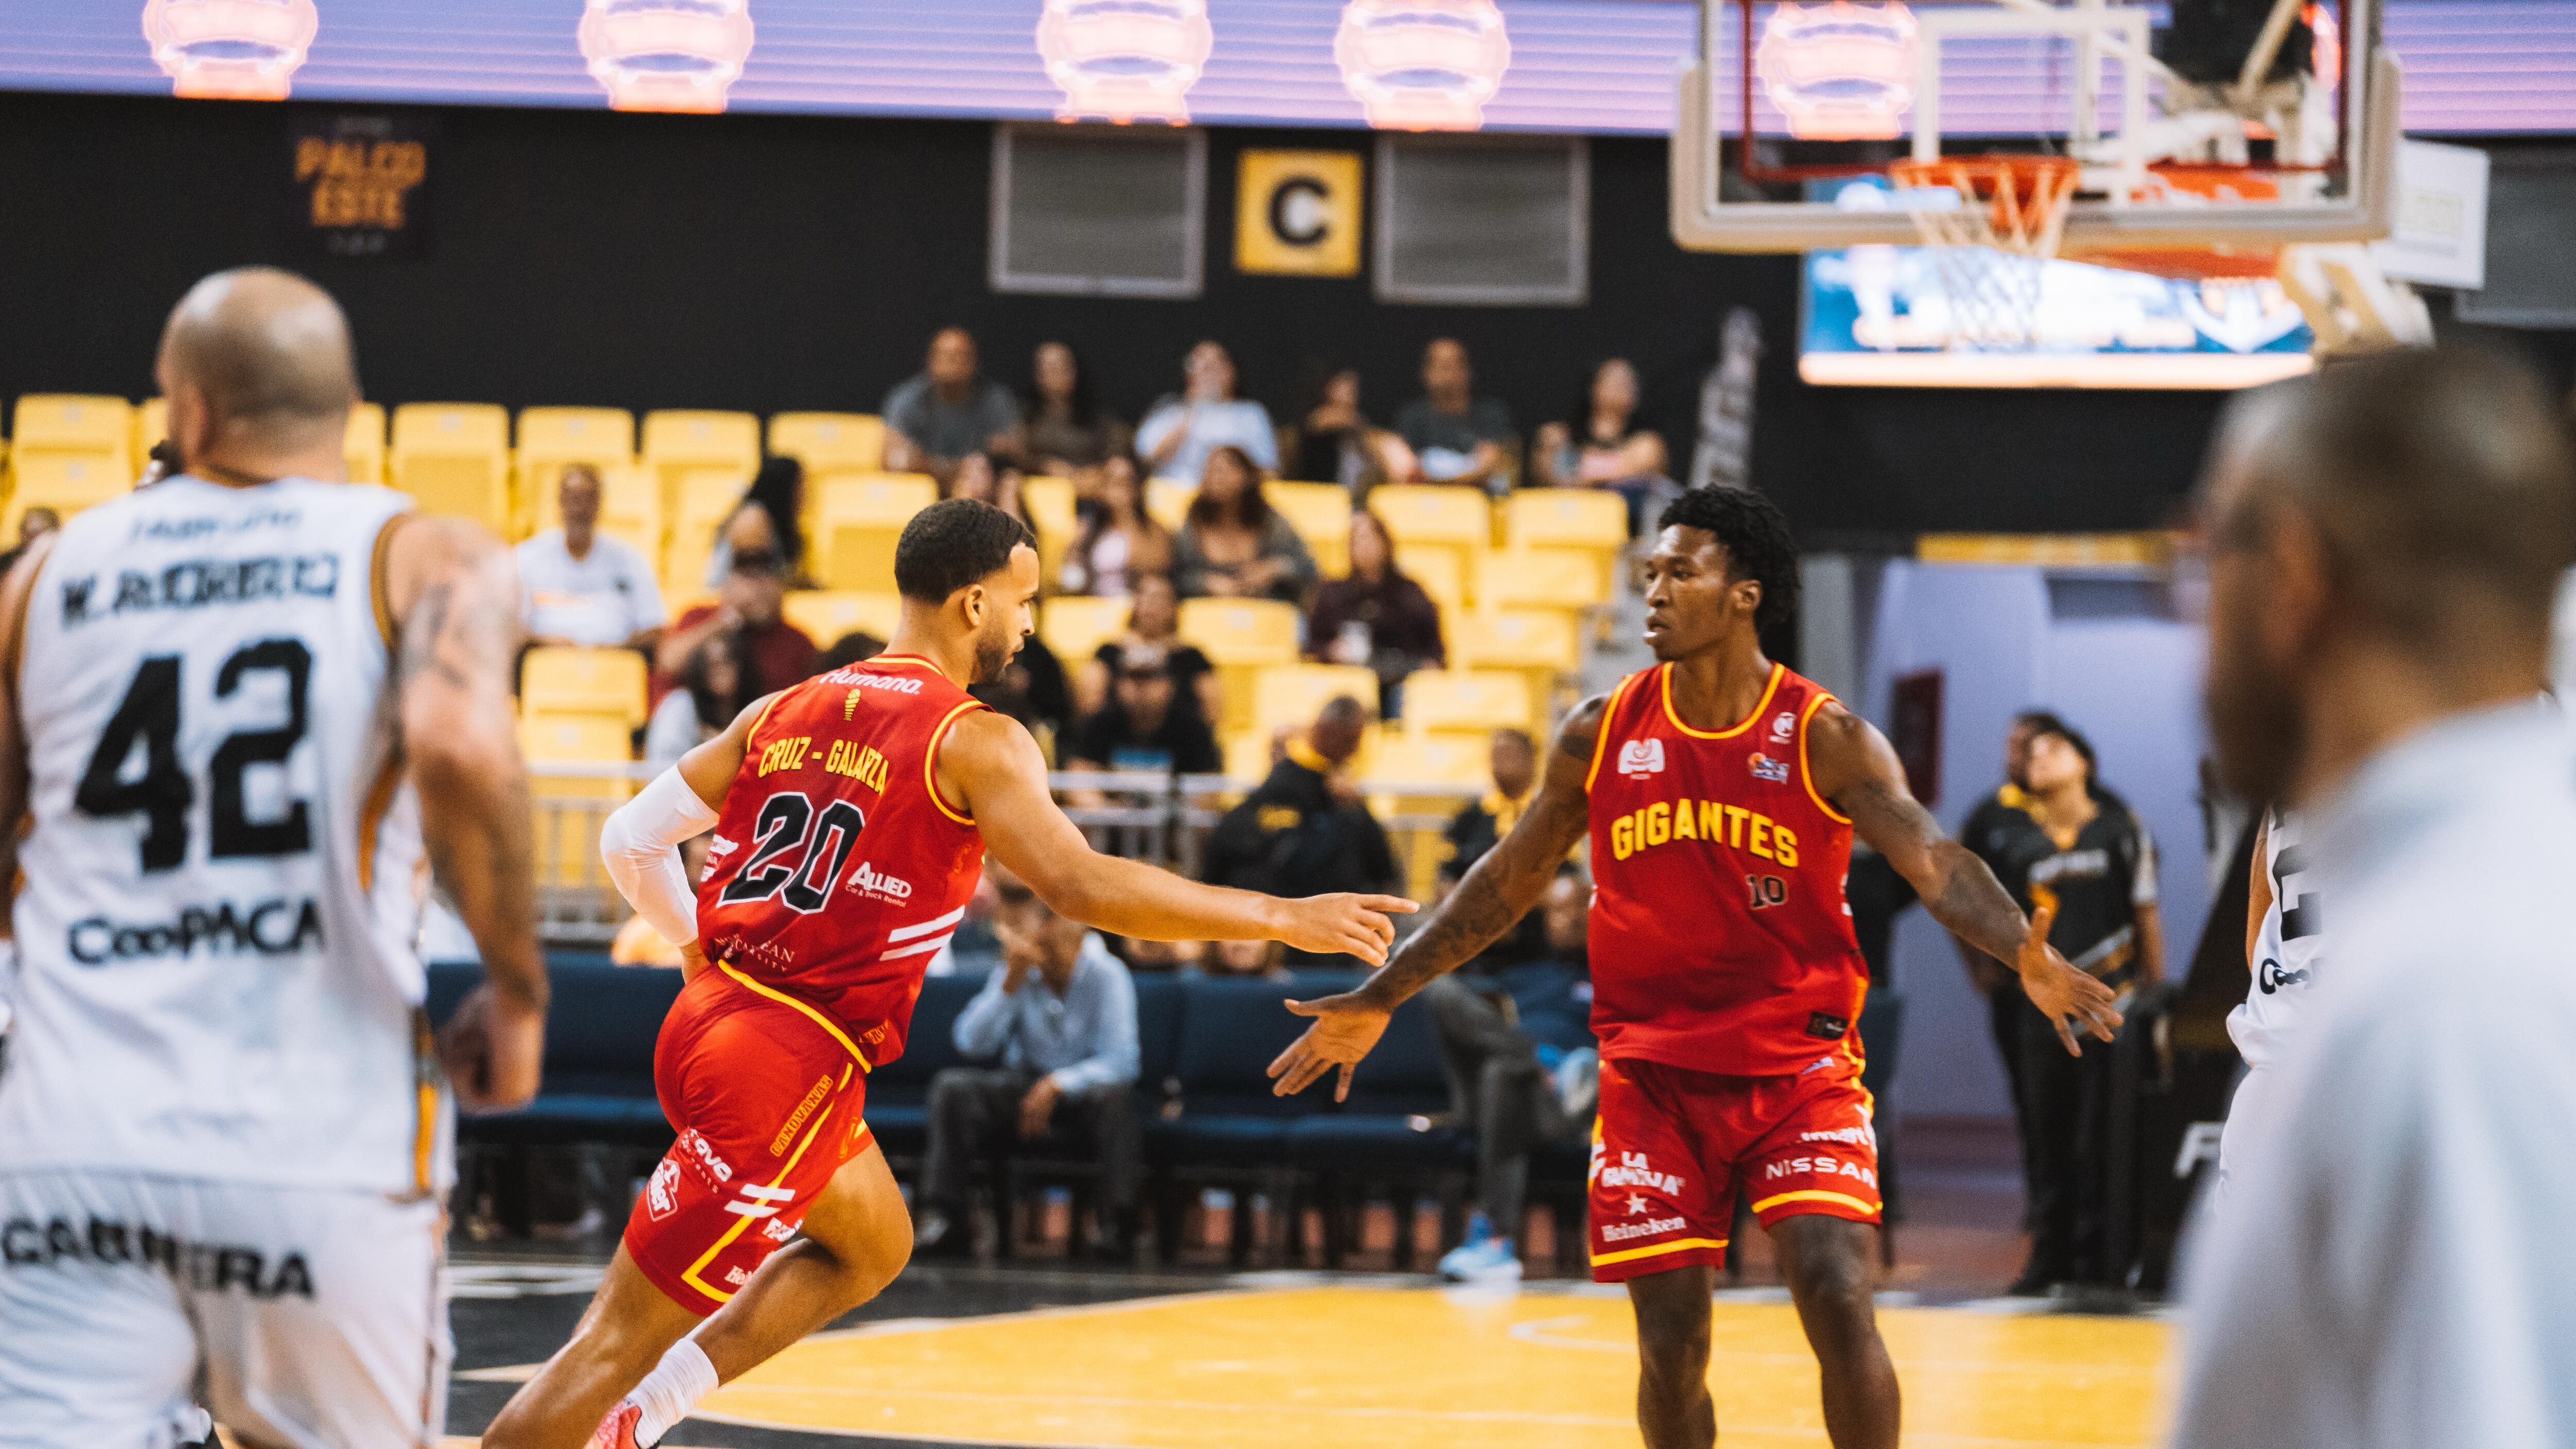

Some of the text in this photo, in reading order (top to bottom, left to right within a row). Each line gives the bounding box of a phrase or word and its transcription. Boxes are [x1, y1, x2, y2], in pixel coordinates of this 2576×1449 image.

[1268, 174, 1332, 250] C
[75, 637, 313, 874] 42
[758, 736, 812, 778] CRUZ
[825, 739, 889, 797] GALARZA
[716, 791, 866, 915] 20
[1611, 798, 1799, 868] GIGANTES
[1744, 874, 1788, 910] 10
[1766, 1157, 1876, 1189] NISSAN
[1601, 1216, 1687, 1242] Heineken
